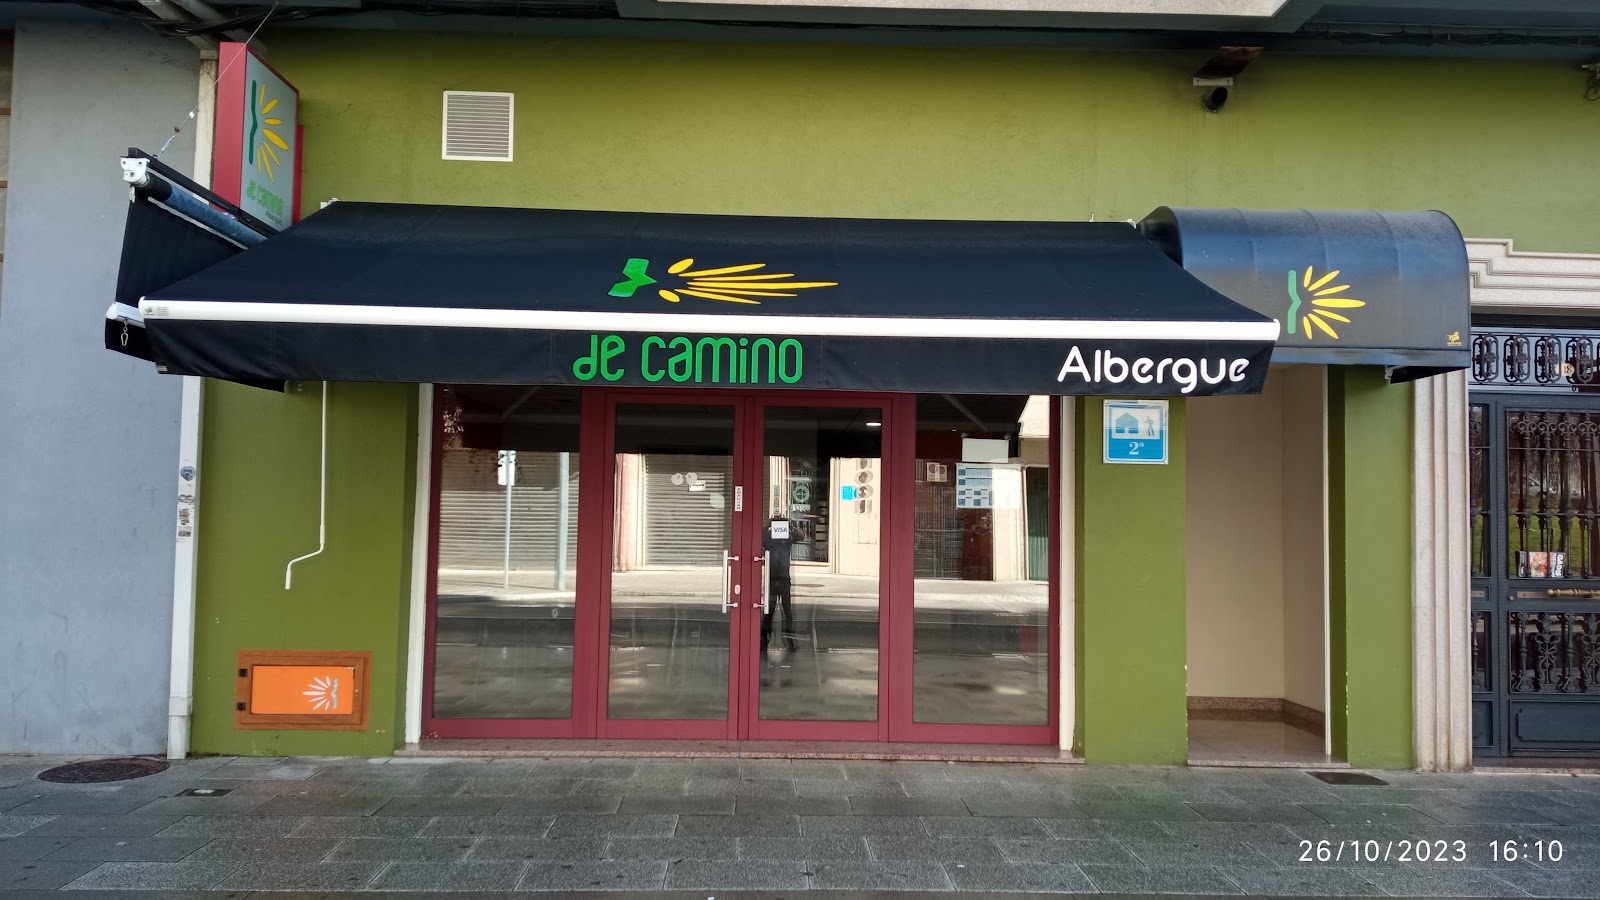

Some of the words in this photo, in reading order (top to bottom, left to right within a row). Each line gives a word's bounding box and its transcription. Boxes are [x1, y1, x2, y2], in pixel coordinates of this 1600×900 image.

[572, 334, 626, 381] de
[641, 336, 803, 384] camino
[1057, 345, 1250, 394] Albergue
